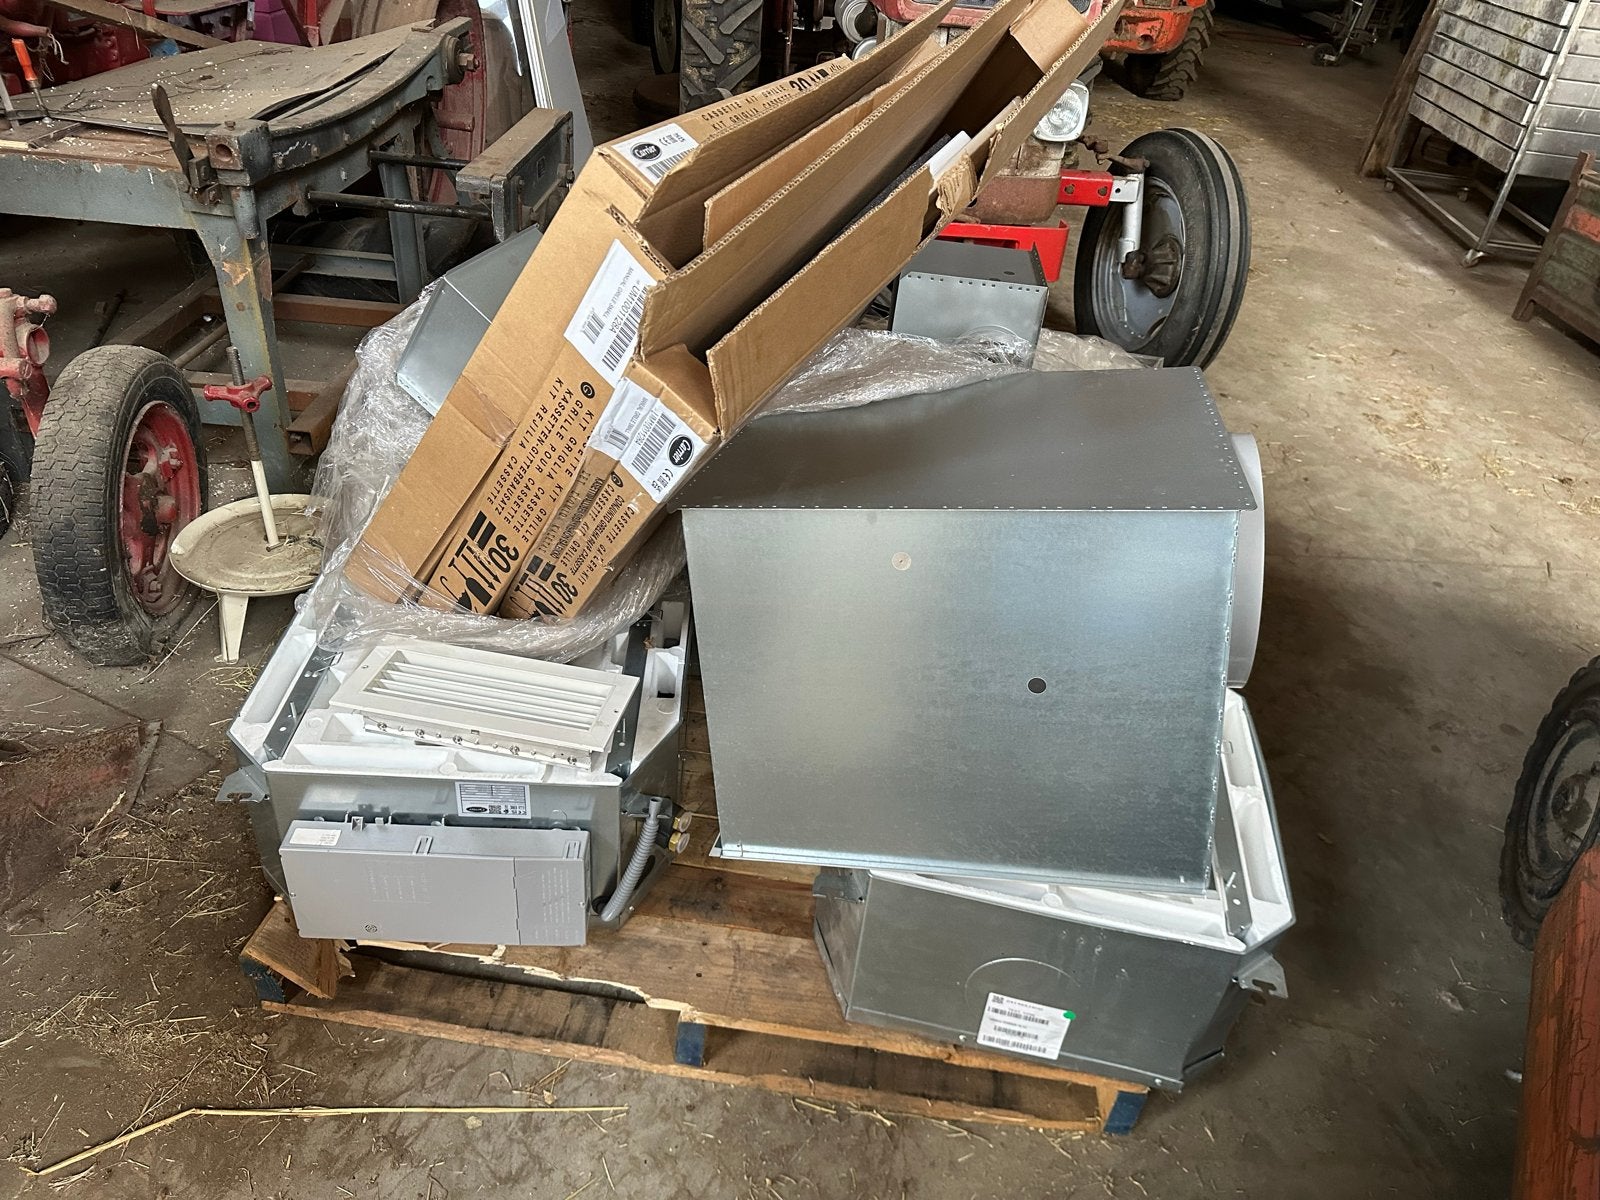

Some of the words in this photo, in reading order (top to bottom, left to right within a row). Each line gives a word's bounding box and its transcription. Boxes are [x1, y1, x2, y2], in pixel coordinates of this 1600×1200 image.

[702, 101, 742, 121] CASSETTE
[745, 95, 758, 104] KIT
[761, 84, 786, 97] GRILLE
[712, 120, 726, 130] KIT
[729, 107, 759, 123] GRIGLIA
[634, 144, 656, 156] Carrier
[608, 285, 639, 333] UM1001128A
[547, 377, 563, 399] KIT
[518, 404, 548, 449] REJILIA
[555, 399, 583, 439] GRILLE
[578, 409, 593, 430] KIT
[494, 388, 573, 514] KASSETTEN-GITTERBAUSATZ
[534, 443, 556, 473] POUR
[545, 436, 576, 480] GRIGLIA
[670, 438, 691, 463] Carrier
[485, 455, 518, 505] CASSETTE
[547, 483, 562, 502] KIT
[503, 476, 535, 524] CASSETTE
[512, 486, 544, 533] CASSETTE
[590, 483, 614, 517] CASSETTE
[602, 494, 624, 522] CONJUNTO
[521, 507, 546, 542] GRILLE
[578, 521, 590, 536] KIT
[590, 518, 607, 540] GRELHA
[604, 505, 635, 542] CASSETTE
[484, 532, 521, 573] 30
[560, 540, 580, 567] GRILLE
[568, 547, 589, 576] CASSETTE
[549, 570, 579, 604] 30
